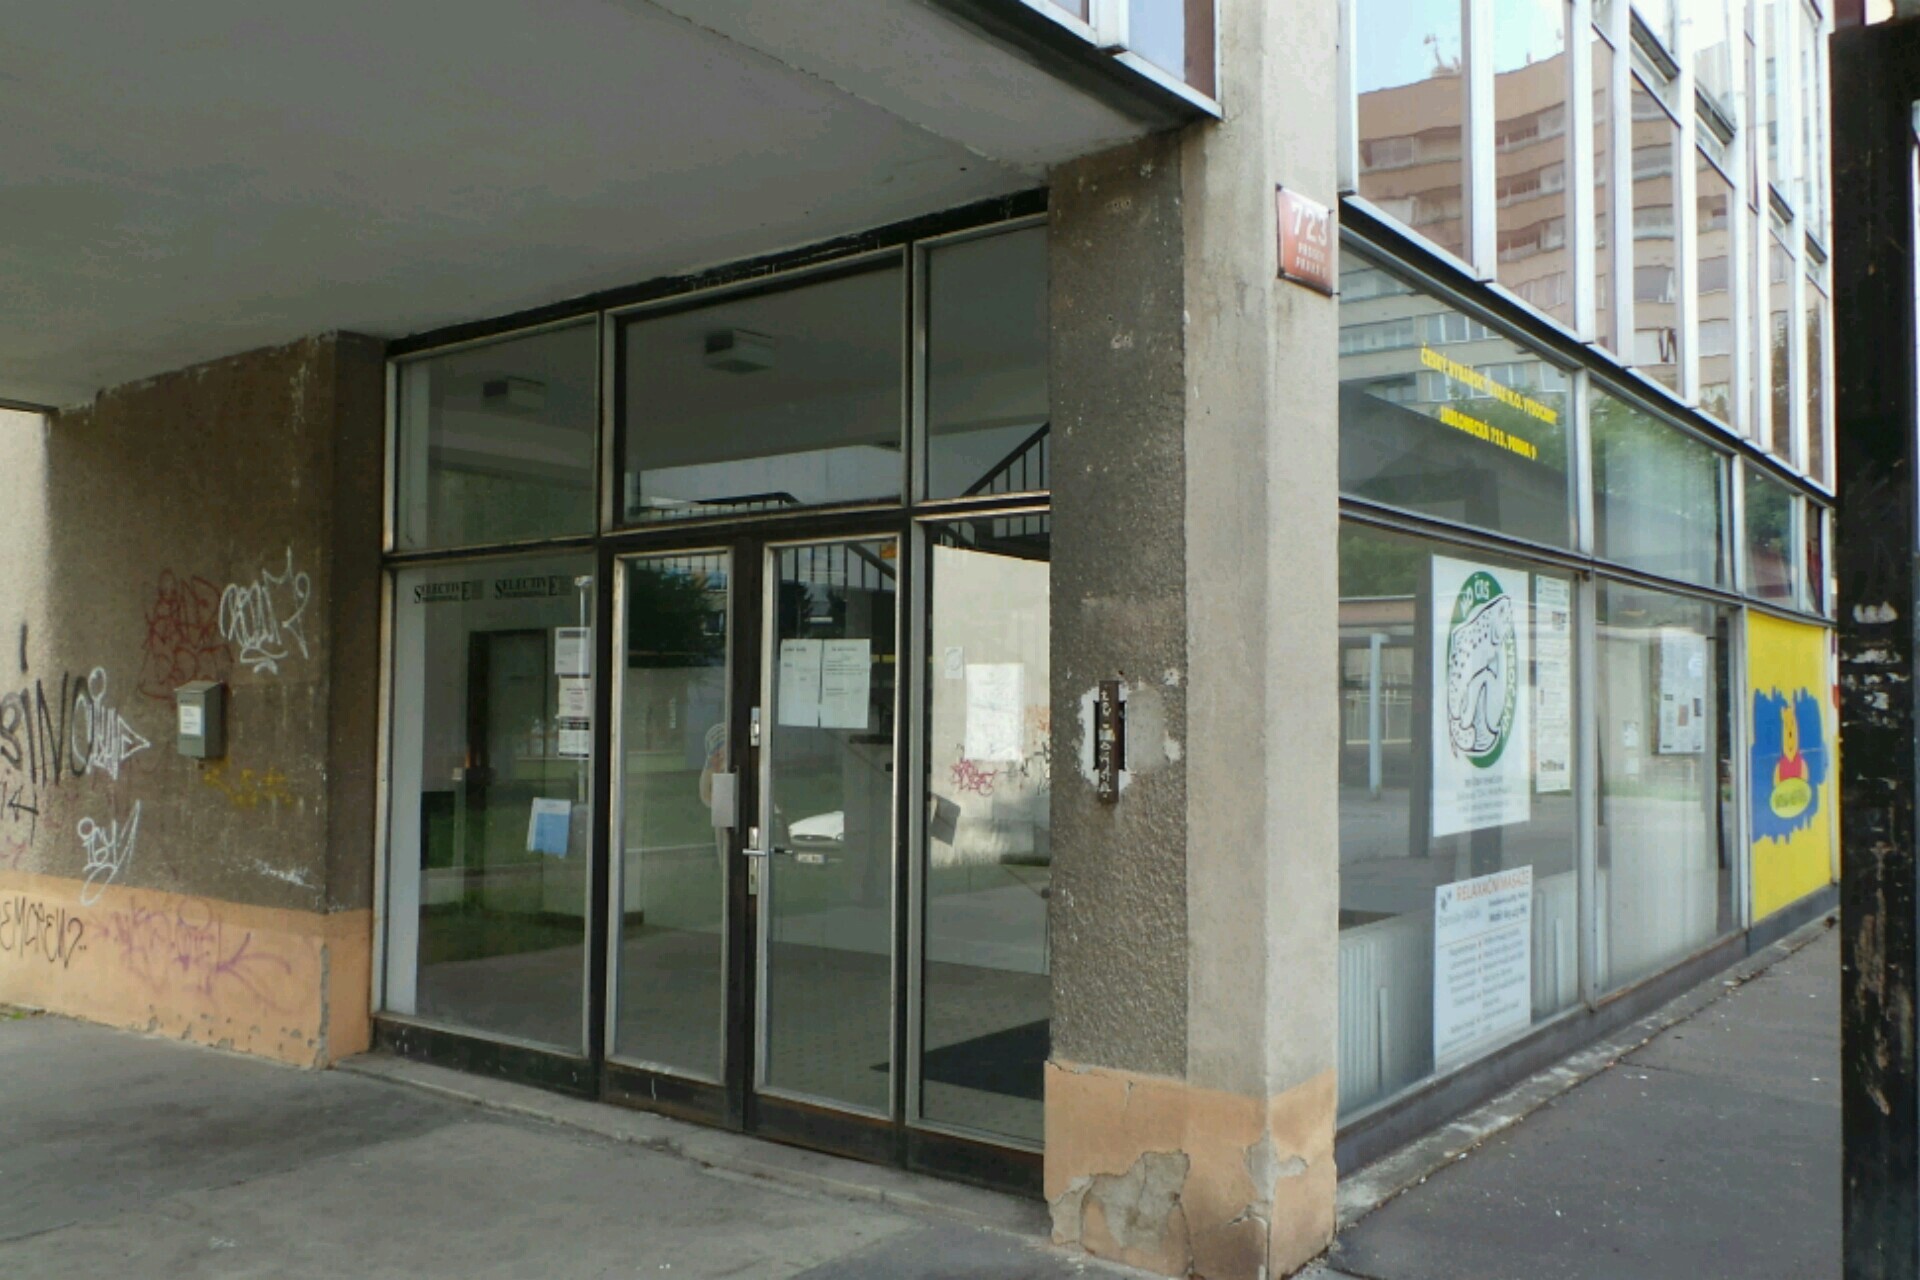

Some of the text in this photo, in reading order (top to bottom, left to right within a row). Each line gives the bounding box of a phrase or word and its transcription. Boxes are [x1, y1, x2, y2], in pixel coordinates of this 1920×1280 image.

[1291, 203, 1327, 246] 723
[1420, 342, 1447, 373] ČESKÝ
[414, 581, 470, 604] SELECTIVE
[495, 575, 557, 600] SELECTIVE
[1474, 575, 1490, 601] ČRS
[1456, 877, 1499, 902] RELAXAČNÍ
[1499, 868, 1530, 893] MASÁŽE
